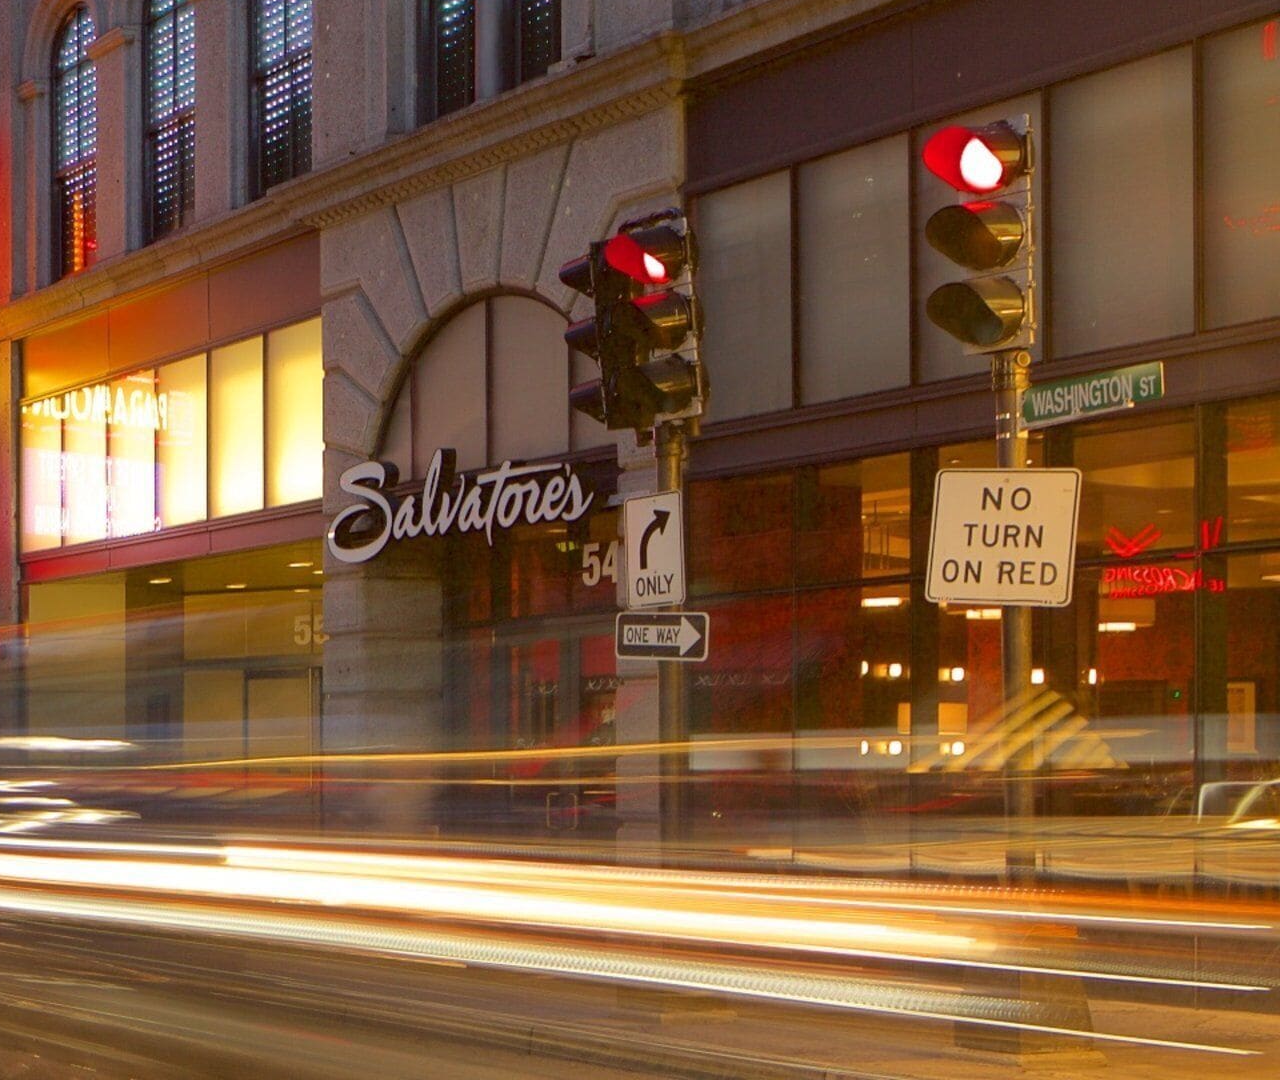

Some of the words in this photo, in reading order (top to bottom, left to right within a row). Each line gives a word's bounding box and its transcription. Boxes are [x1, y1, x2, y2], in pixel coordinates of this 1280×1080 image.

[1031, 375, 1133, 416] WASHINGTON
[1139, 376, 1157, 398] ST
[327, 449, 594, 563] Salvatore's
[981, 487, 1032, 511] NO
[963, 524, 1044, 549] TURN
[635, 573, 675, 597] ONLY
[942, 560, 982, 584] ON
[998, 561, 1058, 586] RED
[625, 625, 650, 644] ONE
[656, 625, 681, 644] WAY
